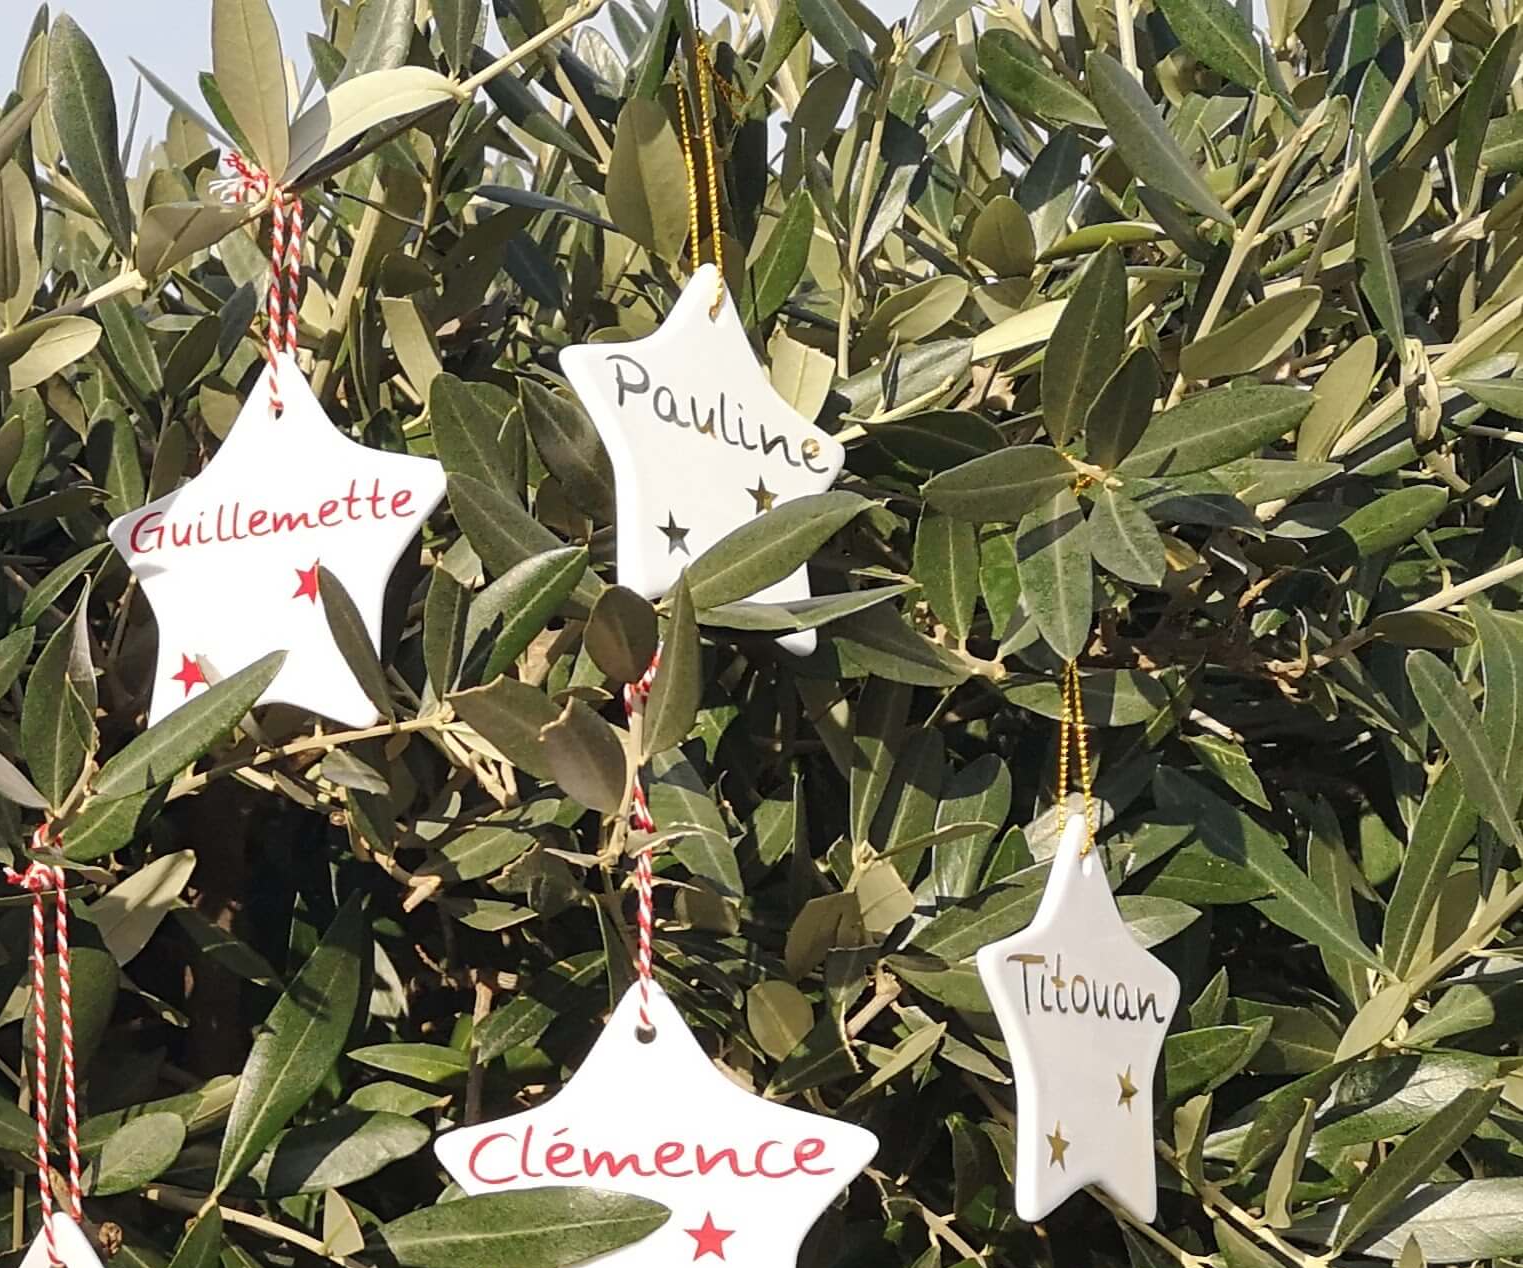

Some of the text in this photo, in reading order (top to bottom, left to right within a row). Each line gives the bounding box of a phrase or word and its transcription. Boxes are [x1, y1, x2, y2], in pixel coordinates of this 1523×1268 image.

[606, 353, 830, 474] Pauline
[129, 477, 416, 554] Guillemette
[1005, 953, 1166, 1024] Titouan
[467, 1125, 835, 1185] Clémence
